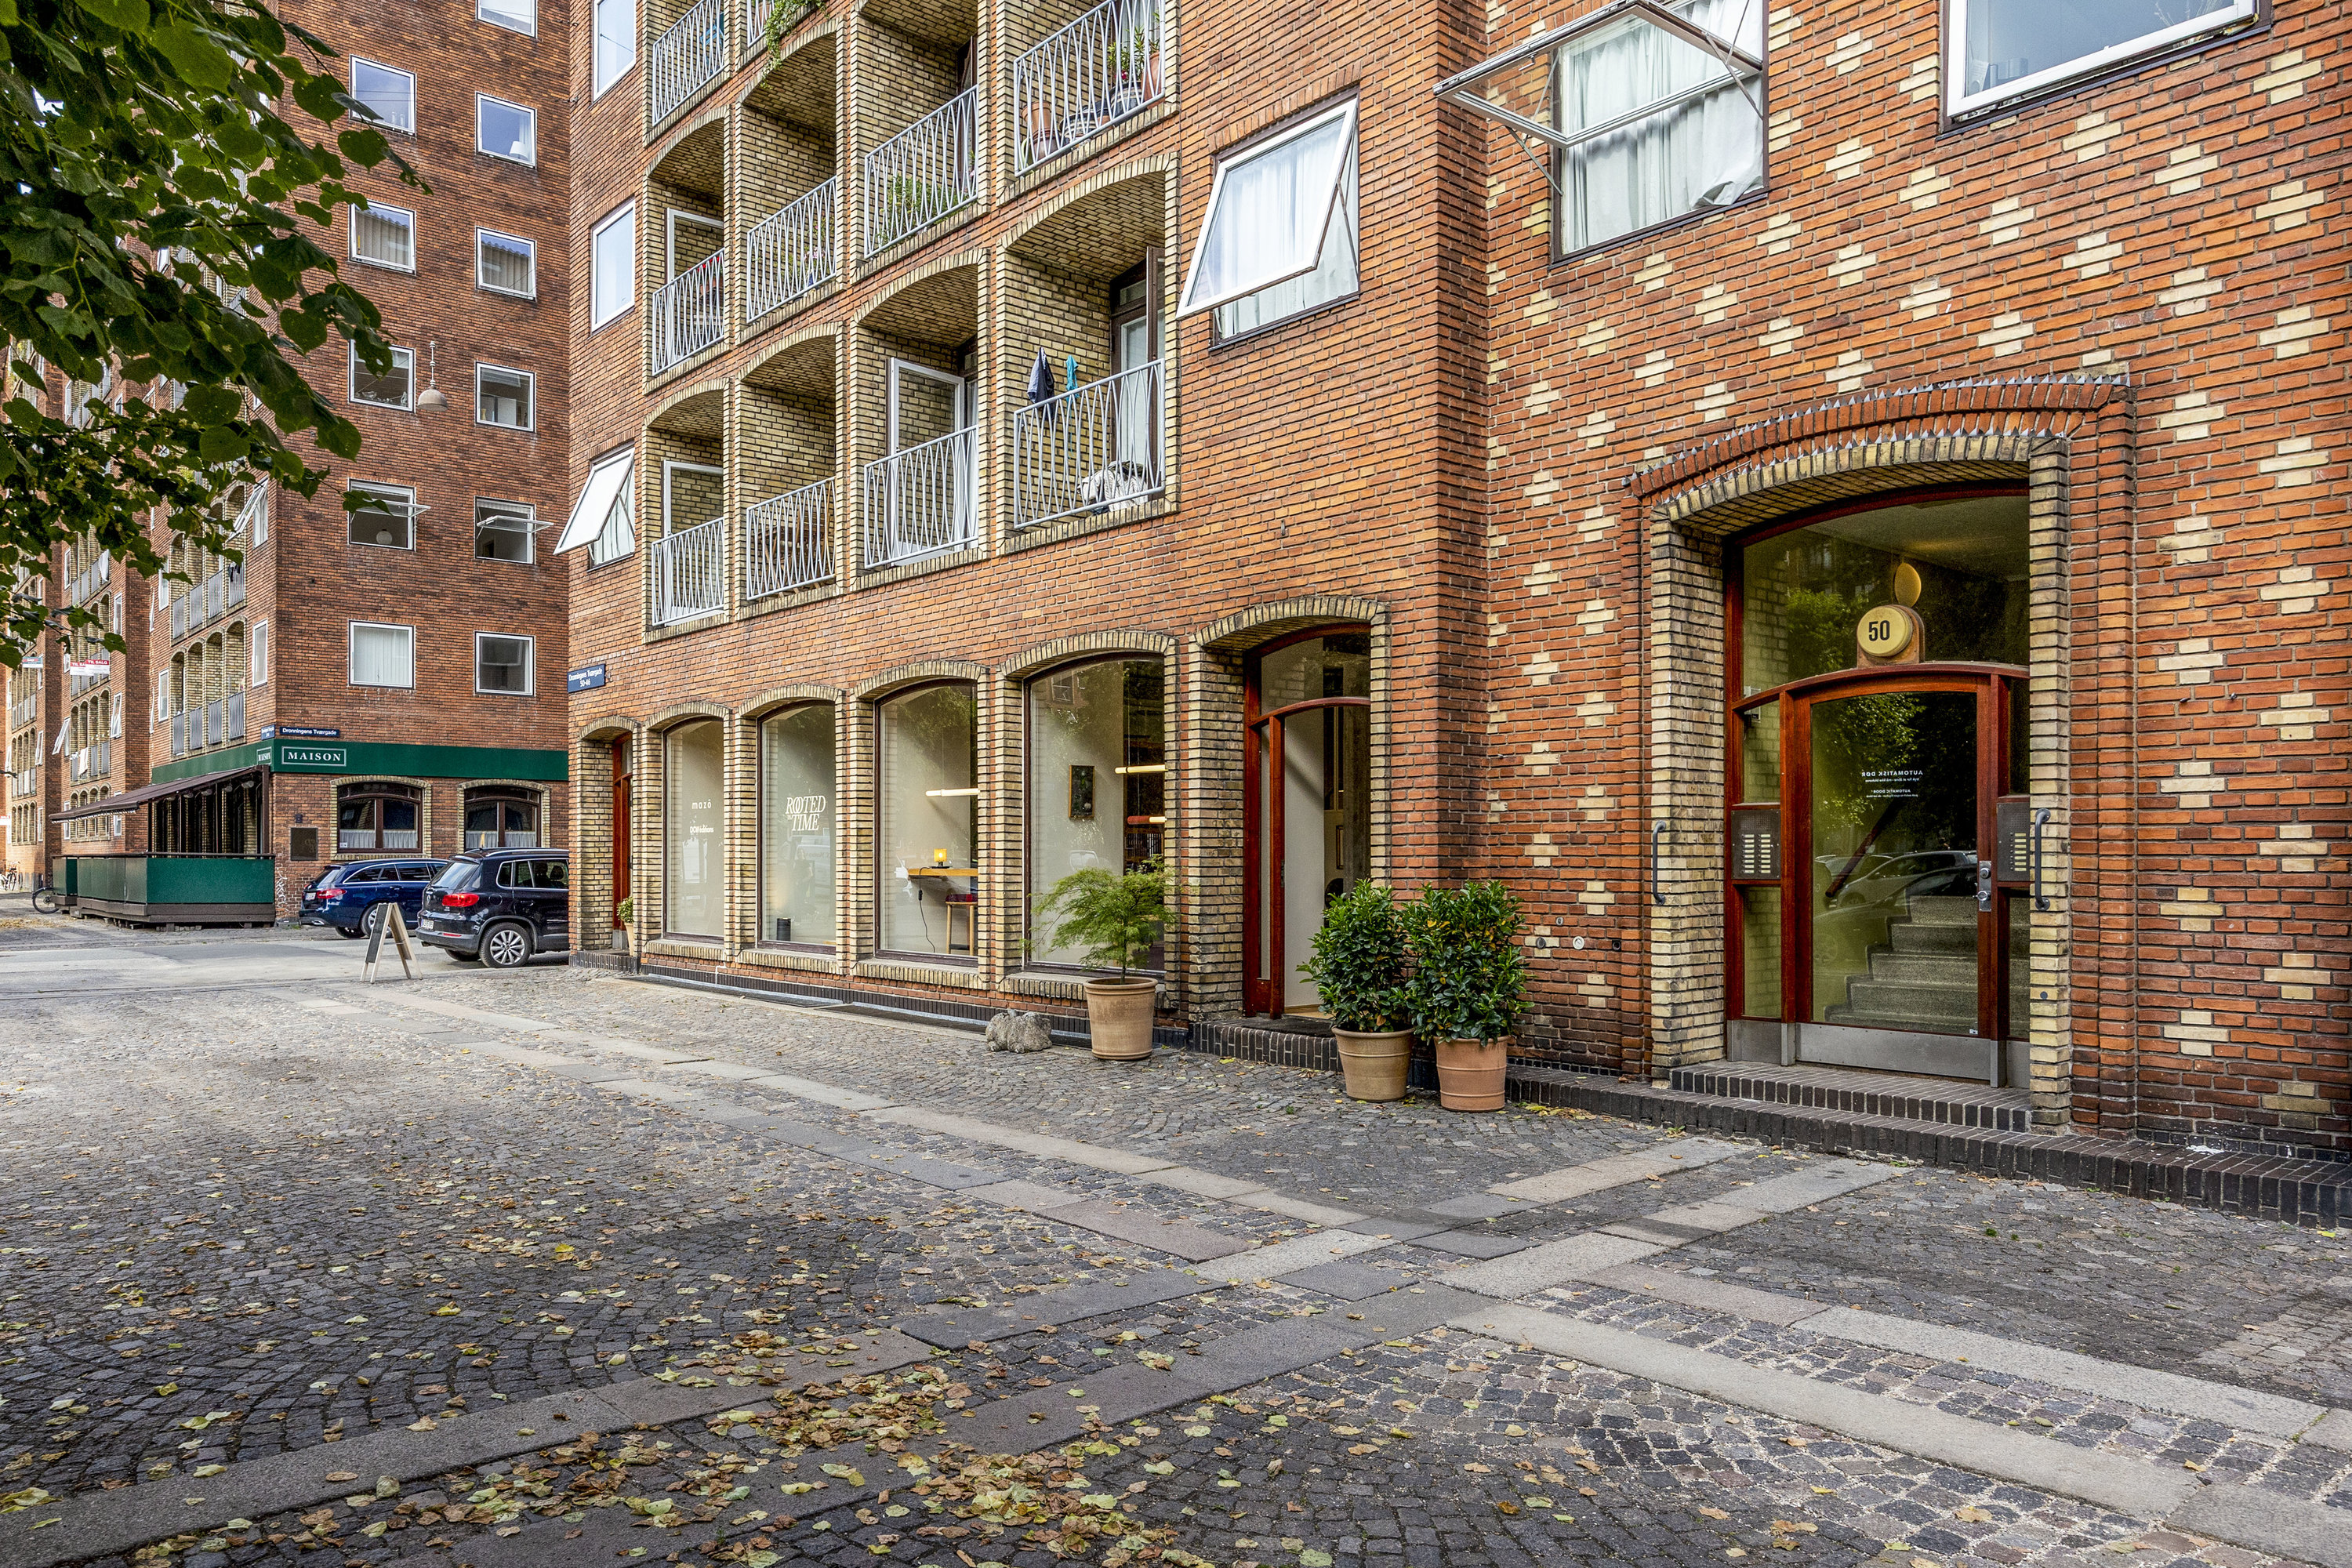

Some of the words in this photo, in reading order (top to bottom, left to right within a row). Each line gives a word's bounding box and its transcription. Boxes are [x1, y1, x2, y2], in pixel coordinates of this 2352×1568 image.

[1869, 620, 1889, 641] 50
[288, 751, 341, 761] MAISON
[785, 795, 826, 815] ROOTED
[792, 813, 820, 831] TIME
